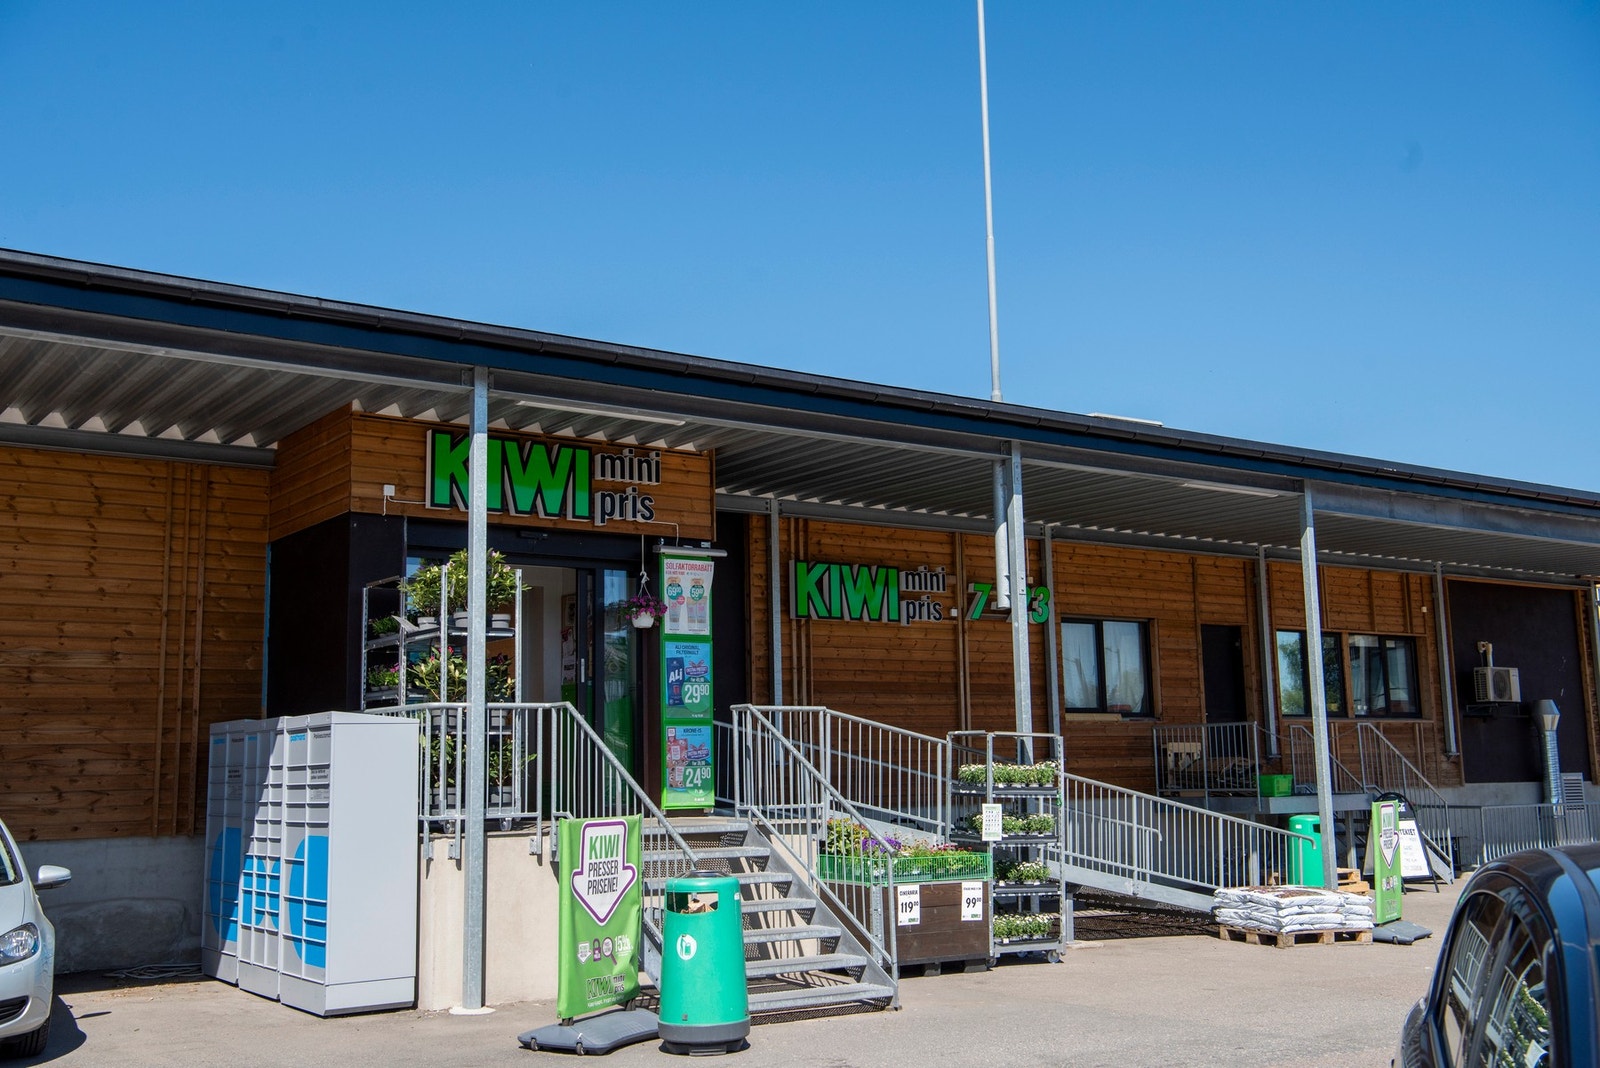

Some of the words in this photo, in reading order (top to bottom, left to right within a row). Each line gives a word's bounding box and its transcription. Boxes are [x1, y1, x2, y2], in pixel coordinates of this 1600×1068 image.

[427, 430, 593, 520] KIWI
[596, 448, 661, 485] mini
[596, 486, 656, 526] pris
[665, 562, 713, 572] SOLFAKTORRABATT
[902, 565, 947, 592] mini
[790, 560, 900, 622] KIWI
[902, 594, 944, 626] pris
[589, 834, 620, 860] KIWI
[588, 859, 619, 878] PRESSER
[587, 876, 619, 896] PRISENE!
[586, 975, 613, 1000] KIWI
